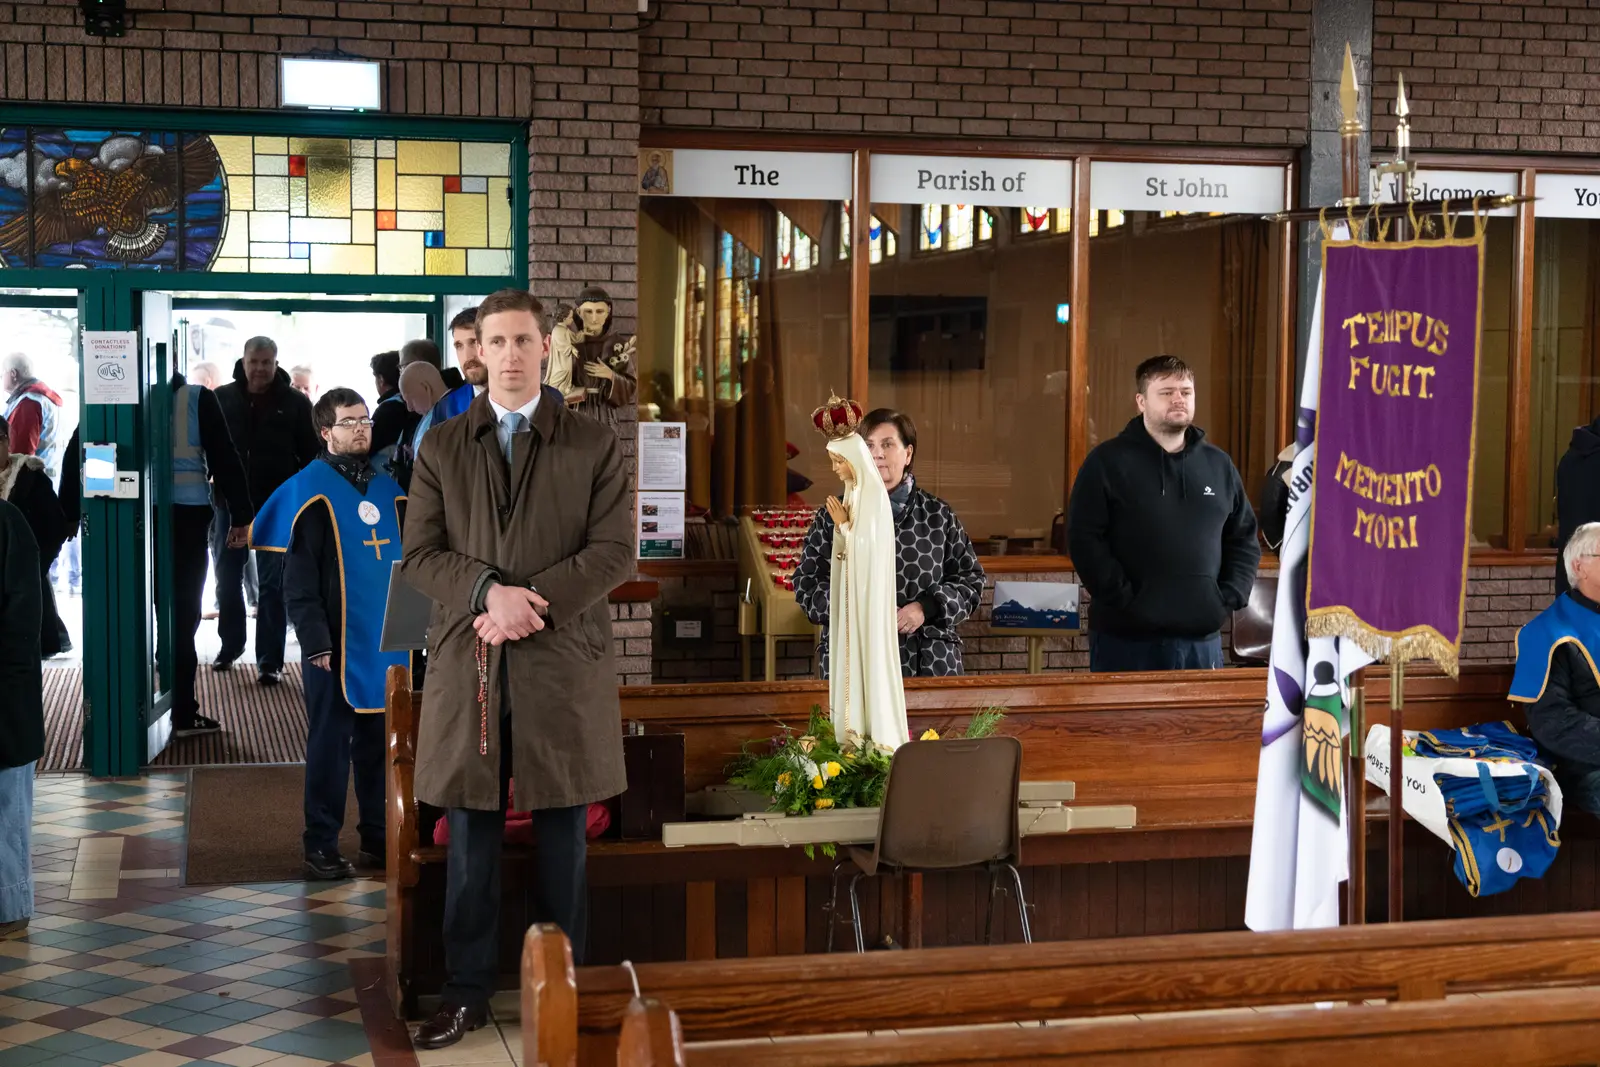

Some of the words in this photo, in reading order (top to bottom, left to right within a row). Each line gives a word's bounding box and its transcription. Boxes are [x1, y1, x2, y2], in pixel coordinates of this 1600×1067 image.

[734, 165, 779, 186] The
[917, 169, 996, 192] Parish
[1002, 171, 1026, 192] of
[1146, 177, 1168, 196] St
[1173, 177, 1228, 198] John
[1574, 187, 1600, 206] Yo
[1342, 309, 1449, 356] TEMPUS
[1348, 355, 1436, 399] FUGIT.
[1334, 450, 1442, 506] MEMENTO
[1353, 506, 1418, 549] MORI
[1406, 776, 1426, 794] YOU
